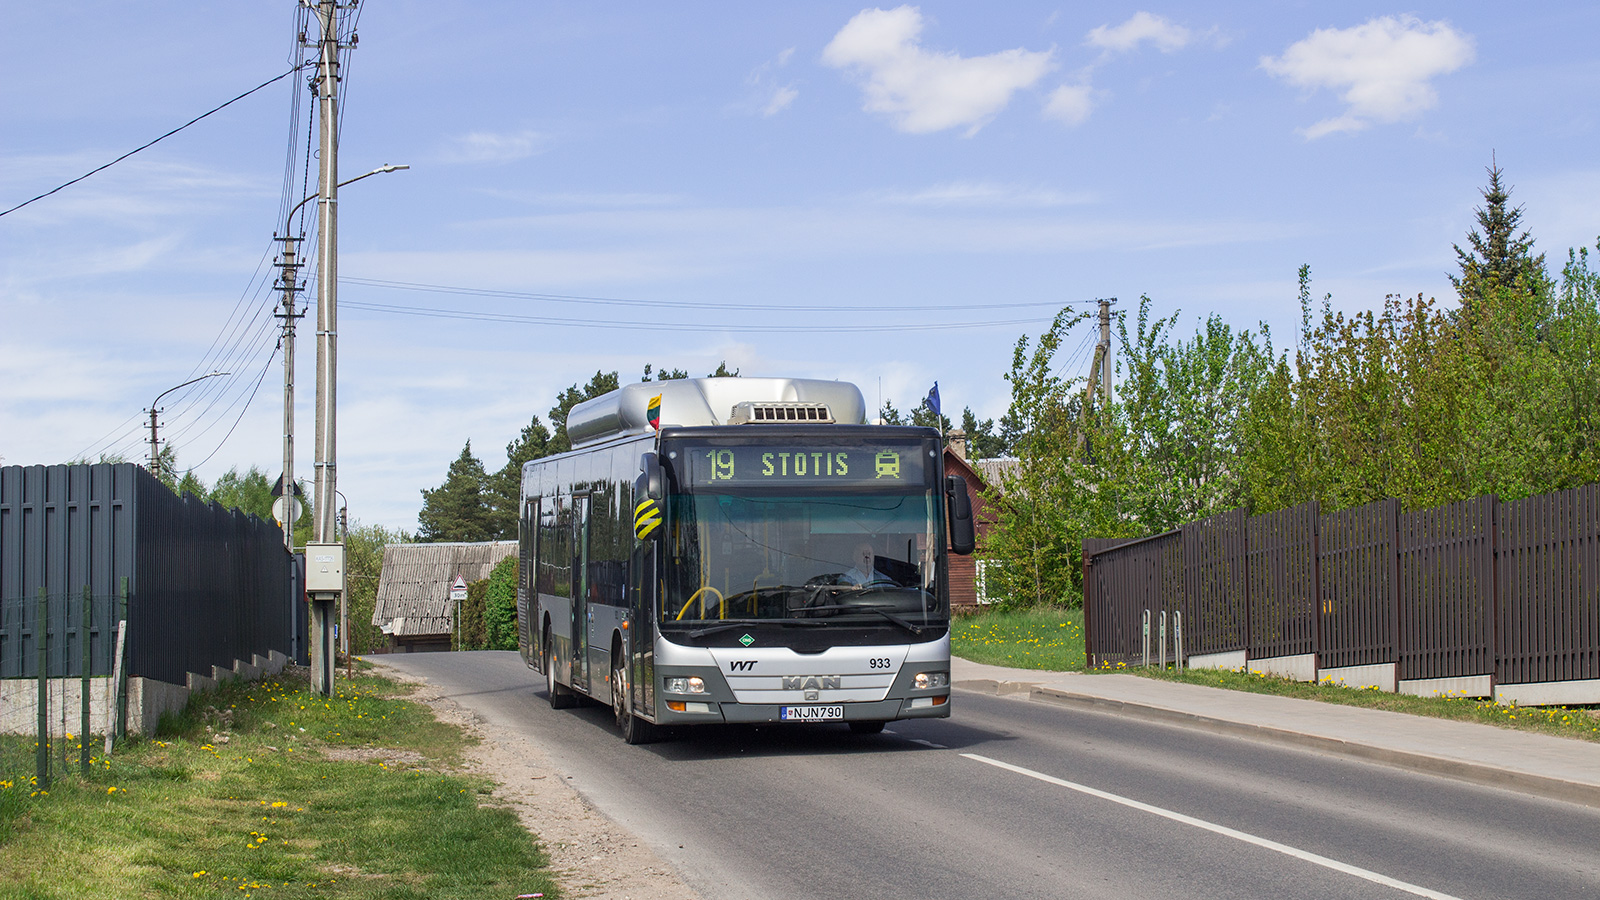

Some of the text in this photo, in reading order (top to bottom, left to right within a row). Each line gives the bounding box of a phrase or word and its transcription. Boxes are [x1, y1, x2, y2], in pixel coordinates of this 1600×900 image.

[706, 449, 848, 479] 19 STOTIS
[730, 660, 758, 672] VVT
[869, 658, 891, 669] 933
[782, 675, 841, 690] MAN
[794, 707, 841, 718] NJN790
